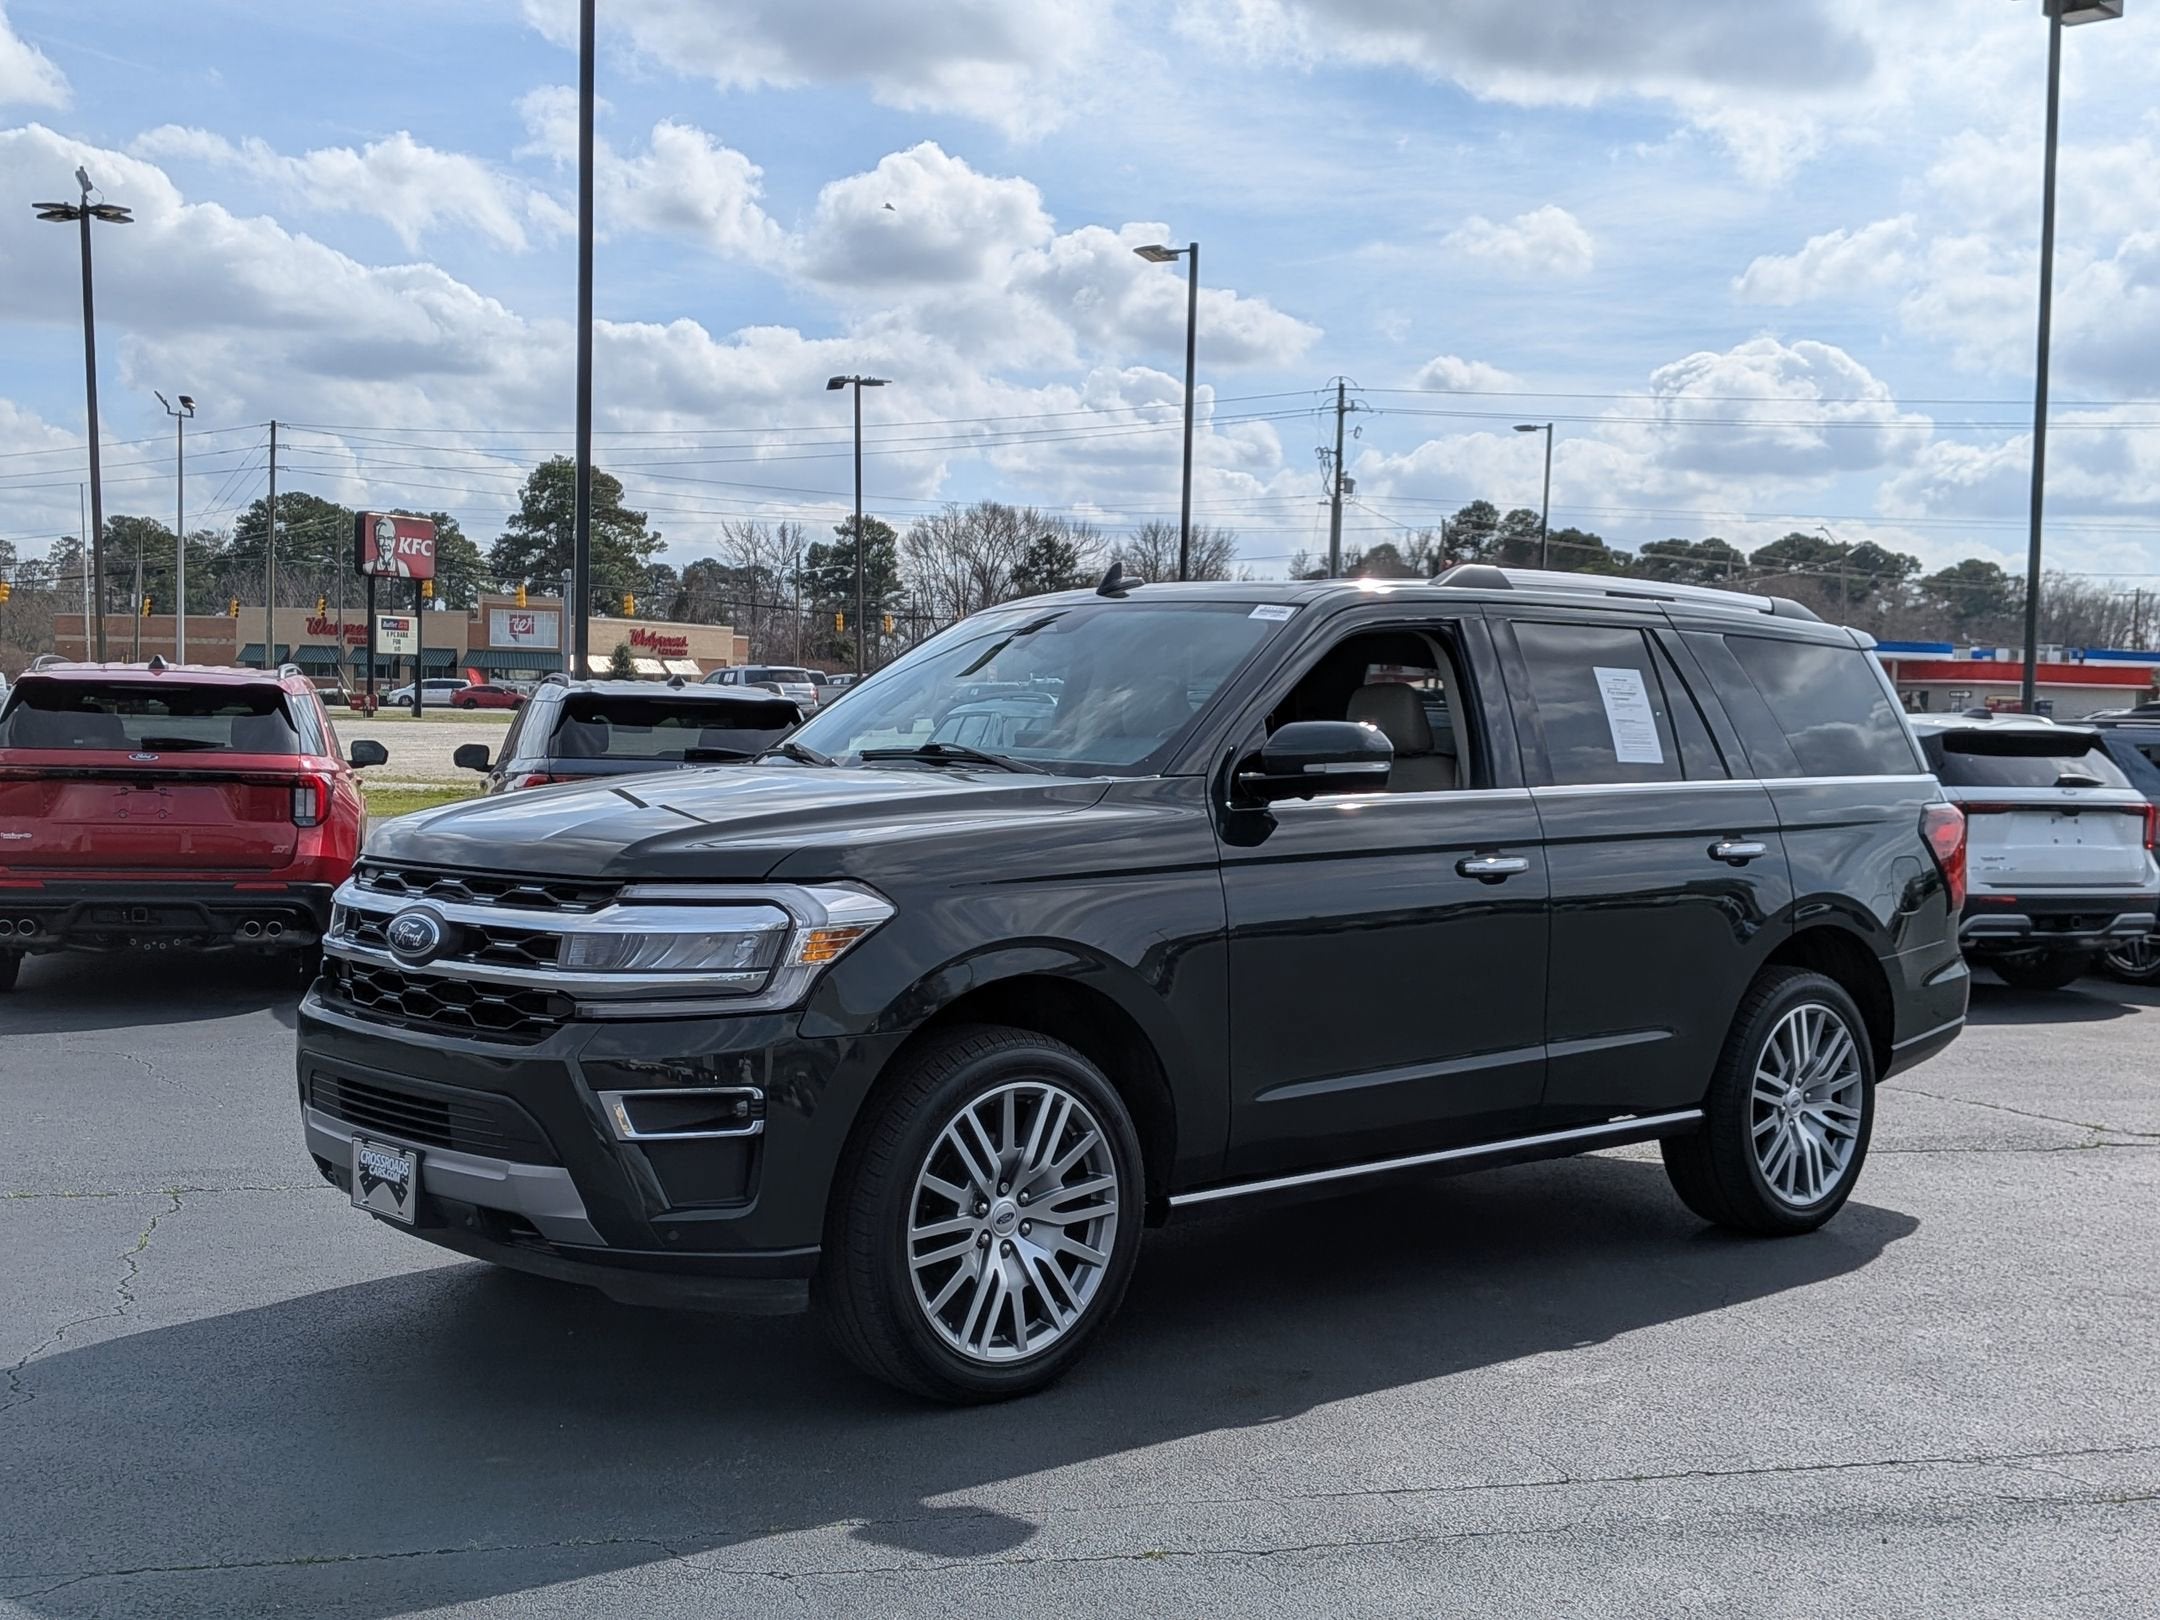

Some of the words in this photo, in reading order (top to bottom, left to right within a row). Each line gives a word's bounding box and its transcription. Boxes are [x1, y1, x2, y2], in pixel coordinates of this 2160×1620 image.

[398, 537, 433, 556] KFC
[395, 921, 425, 947] Ford
[360, 1150, 409, 1176] CROSSROADS
[369, 1165, 400, 1183] CARS.COM
